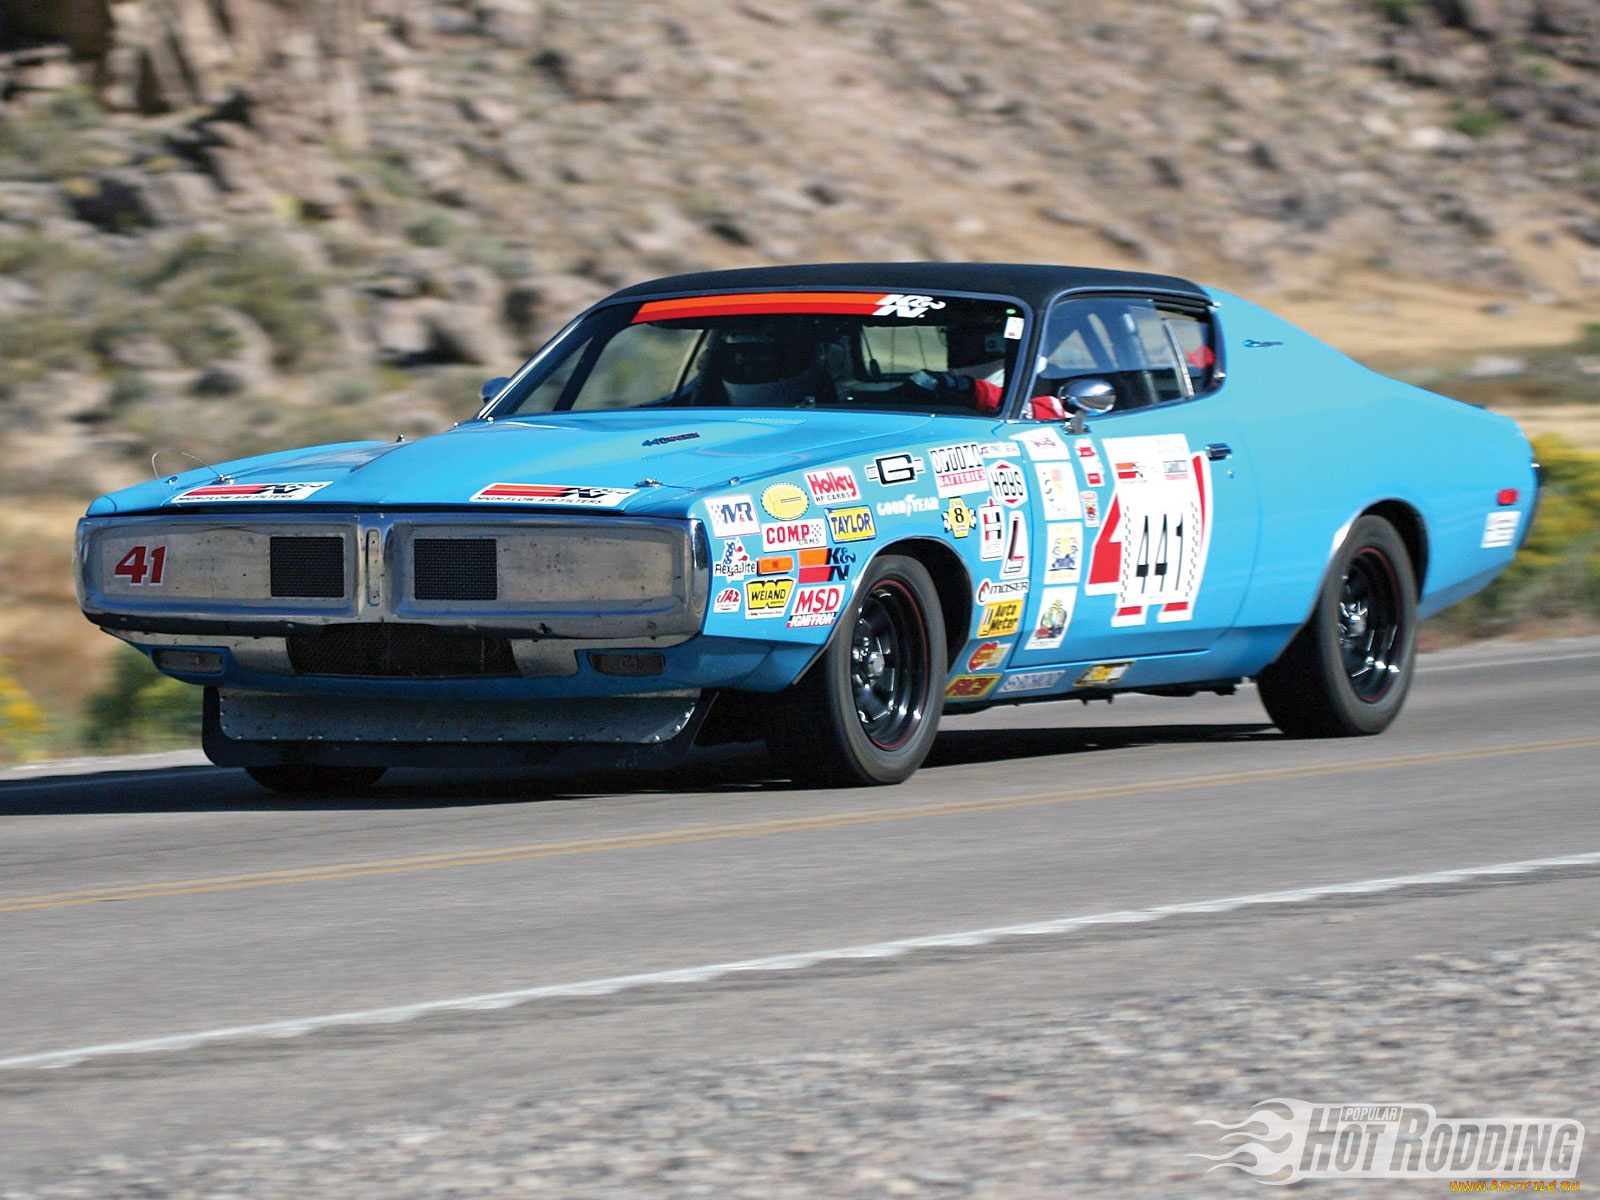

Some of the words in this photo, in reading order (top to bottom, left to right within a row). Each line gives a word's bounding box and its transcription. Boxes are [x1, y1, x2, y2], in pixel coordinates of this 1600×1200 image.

[807, 472, 857, 497] Holley
[937, 470, 986, 487] BATTERIES
[831, 513, 872, 534] TAYLOR
[954, 508, 964, 523] 8
[766, 524, 810, 544] COMP
[1136, 513, 1184, 594] 441
[114, 546, 166, 585] 41
[751, 589, 786, 601] WEIAND
[990, 581, 1029, 594] MOSER
[795, 588, 840, 613] MSD
[791, 612, 835, 627] IGNITION
